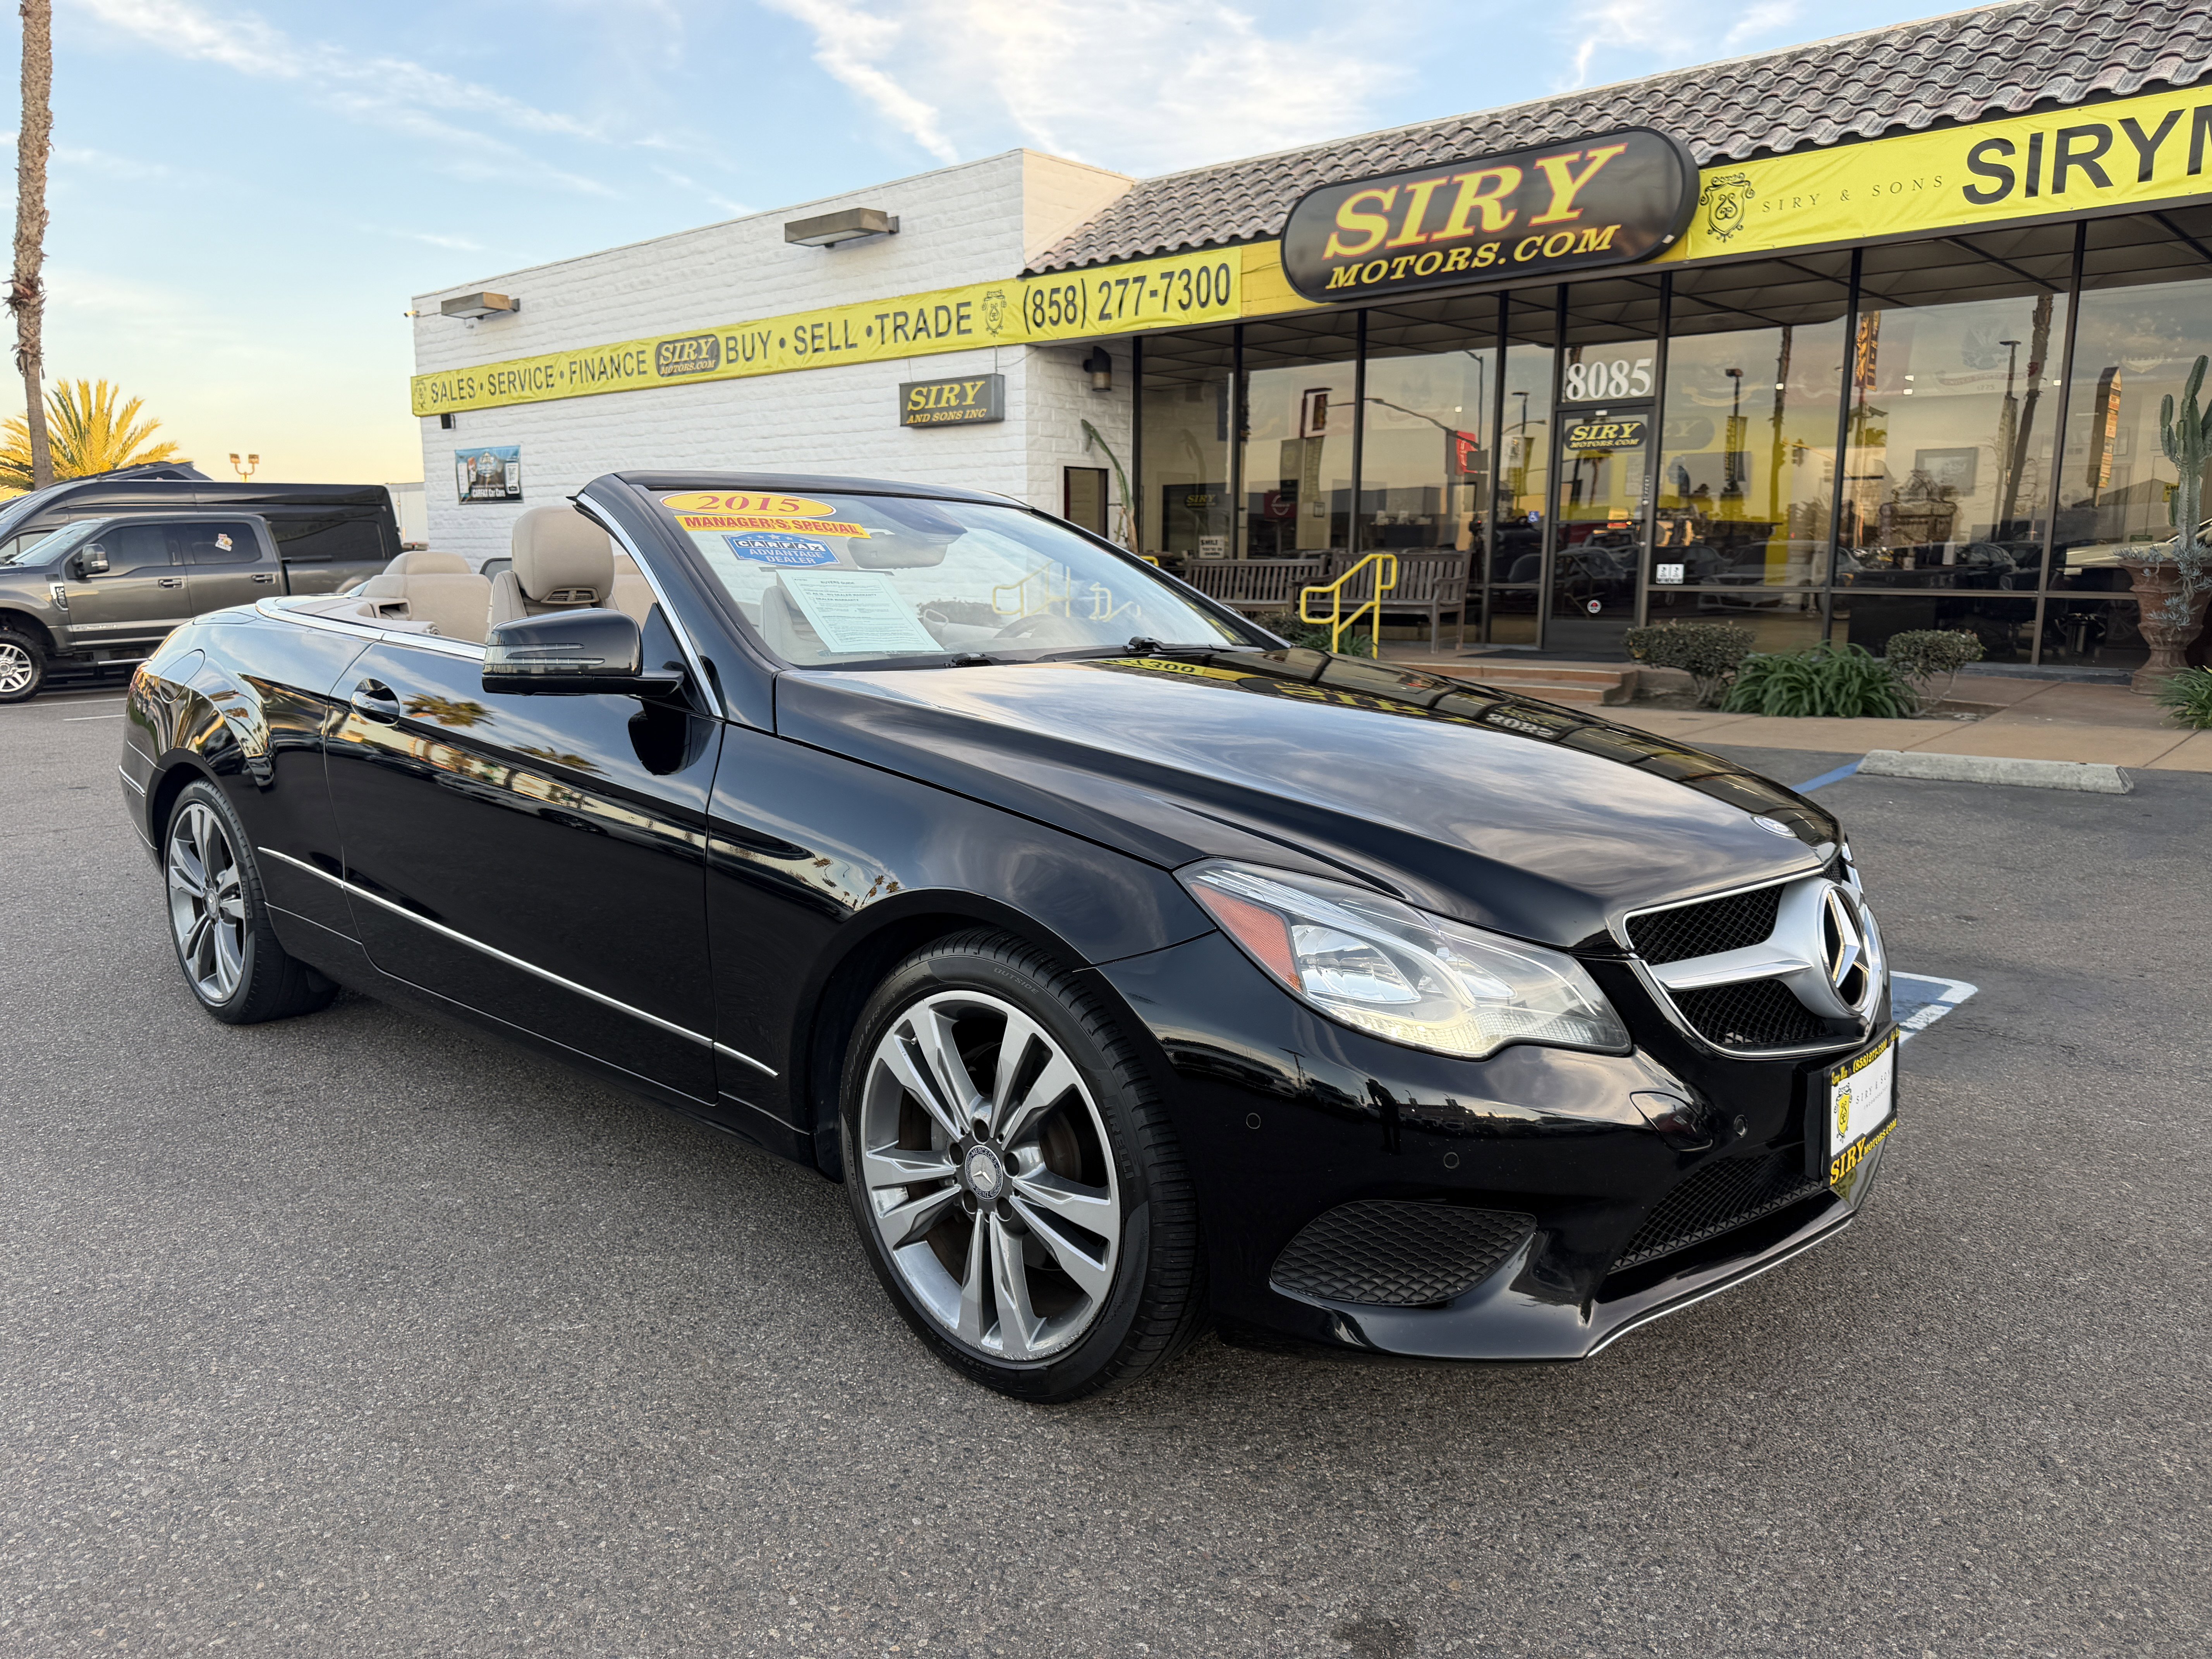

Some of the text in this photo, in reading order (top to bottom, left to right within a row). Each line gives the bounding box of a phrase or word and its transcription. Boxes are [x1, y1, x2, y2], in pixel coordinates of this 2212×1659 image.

[1321, 142, 1628, 260] SIRY
[1762, 175, 1942, 212] SIRY & SONS
[1326, 225, 1621, 289] MOTORS.COM
[1023, 263, 1230, 335] (858) 277-7300
[726, 301, 972, 364] BUY SELL TRADE
[660, 338, 715, 364] SIRY
[431, 350, 647, 403] SALES SERVICE FINANCE
[661, 360, 716, 374] MOTORS.COM
[1566, 359, 1652, 400] 8085
[907, 381, 985, 410] SIRY
[907, 409, 987, 424] AND SONS INC
[1570, 422, 1641, 441] SIRY
[1570, 438, 1640, 448] MOTORS.COM
[696, 496, 800, 512] 2015
[684, 517, 863, 535] MANAGER'S SPECIAL
[736, 541, 826, 551] CARFAX
[750, 548, 824, 558] ADVANTAGE
[766, 556, 816, 564] DEALER
[994, 968, 1039, 994] OUTSIDE
[1103, 1095, 1141, 1179] PIRELLI
[1864, 1118, 1897, 1156] MOTORS.COM
[971, 1148, 998, 1165] MERCEDES
[1830, 1137, 1866, 1185] SIRY
[976, 1188, 991, 1198] BENZ
